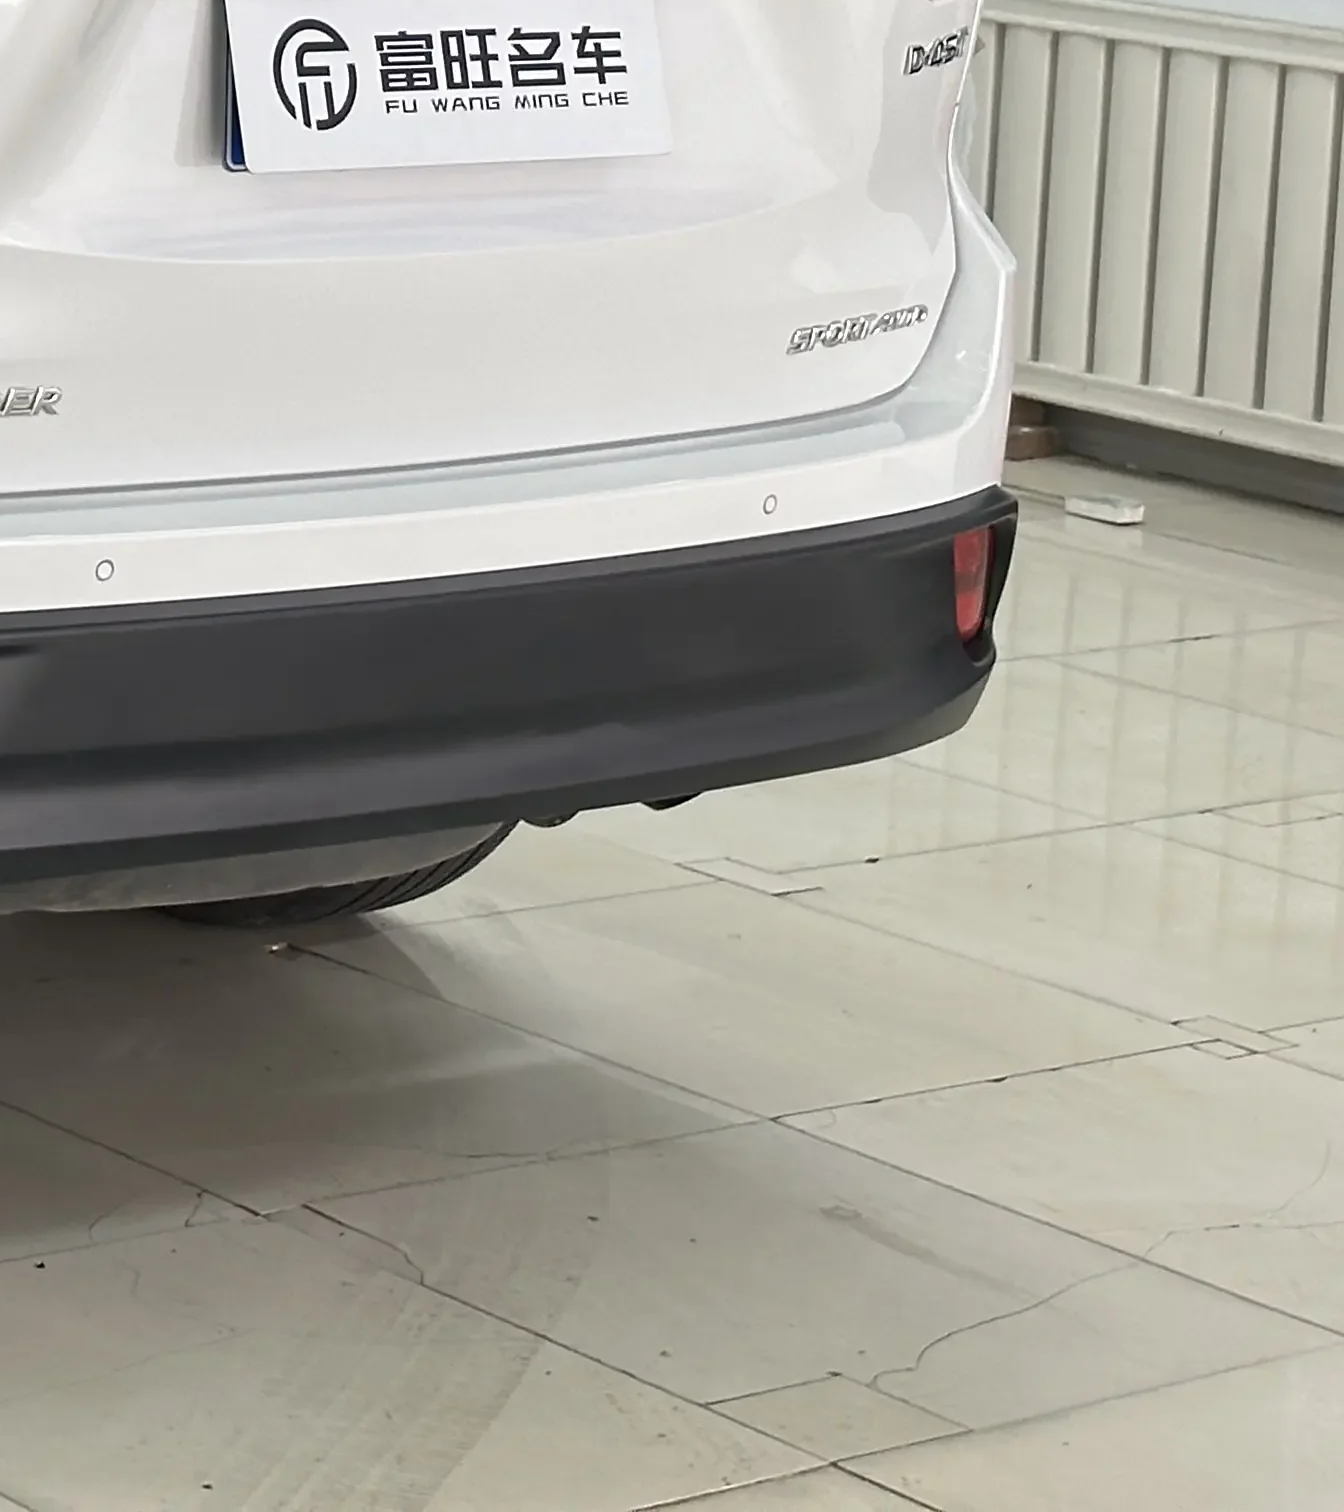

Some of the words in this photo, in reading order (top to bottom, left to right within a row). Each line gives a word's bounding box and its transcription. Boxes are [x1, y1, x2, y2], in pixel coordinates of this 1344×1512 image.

[374, 26, 628, 92] 富旺名车
[385, 98, 418, 114] FU
[432, 95, 501, 113] WANG
[514, 92, 570, 110] MING
[582, 90, 630, 107] CHE
